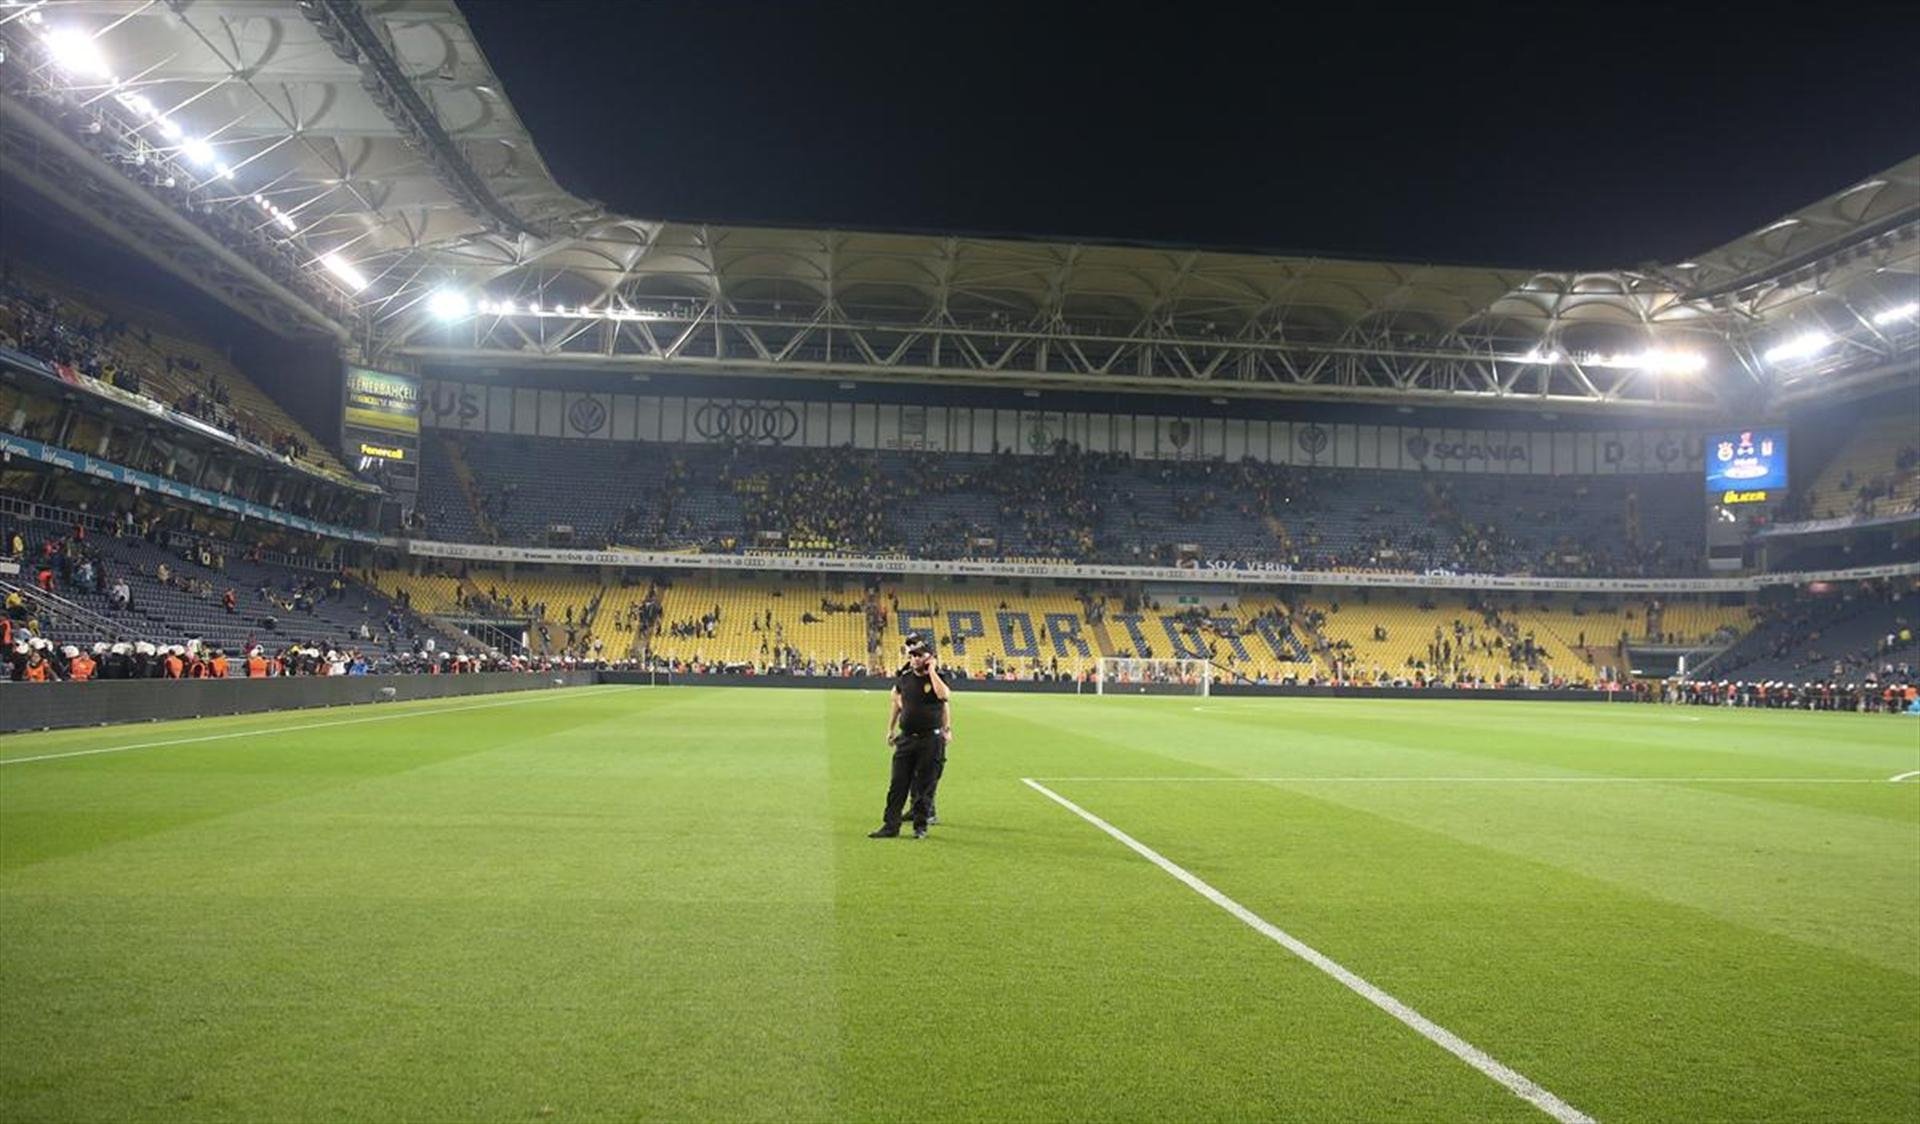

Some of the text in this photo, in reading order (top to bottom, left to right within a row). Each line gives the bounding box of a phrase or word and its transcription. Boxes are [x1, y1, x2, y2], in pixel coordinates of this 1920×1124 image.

[1434, 441, 1527, 462] SCANIA
[899, 611, 1312, 664] SPOR TOTO
